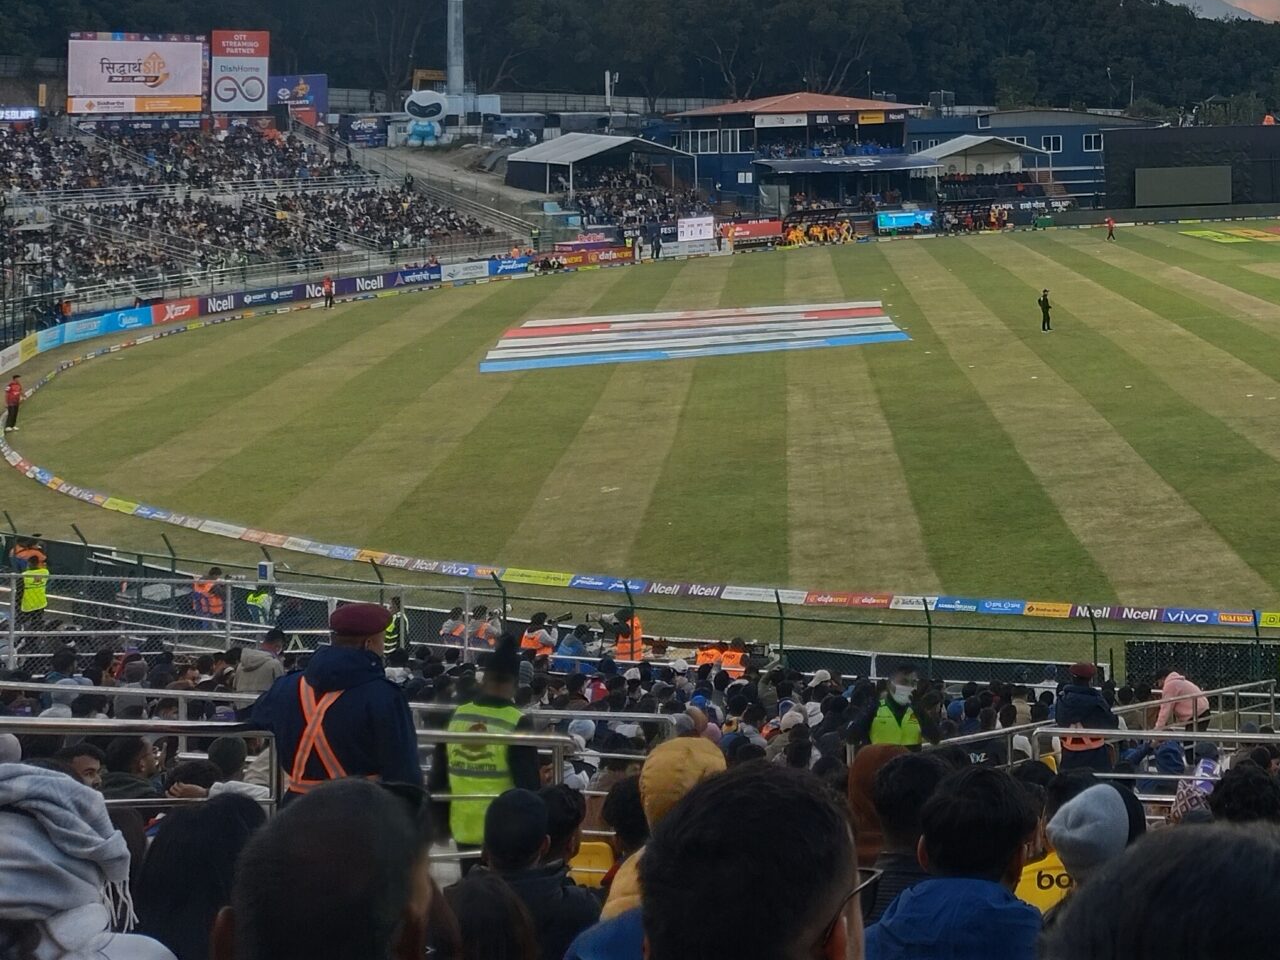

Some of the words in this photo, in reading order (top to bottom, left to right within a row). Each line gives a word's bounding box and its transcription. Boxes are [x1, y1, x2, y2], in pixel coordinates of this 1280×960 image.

[99, 57, 142, 76] सिद्धार्थ
[220, 64, 260, 73] DishHome
[306, 281, 335, 298] Ncl
[356, 275, 383, 291] Ncell
[207, 295, 234, 313] Ncell
[385, 553, 408, 567] Ncell
[412, 558, 439, 571] Ncell
[441, 564, 469, 575] vivo
[649, 582, 680, 595] Ncell
[688, 584, 719, 597] Ncell
[1076, 606, 1110, 618] Ncell
[1122, 607, 1157, 620] Ncell
[1167, 610, 1208, 623] vivo
